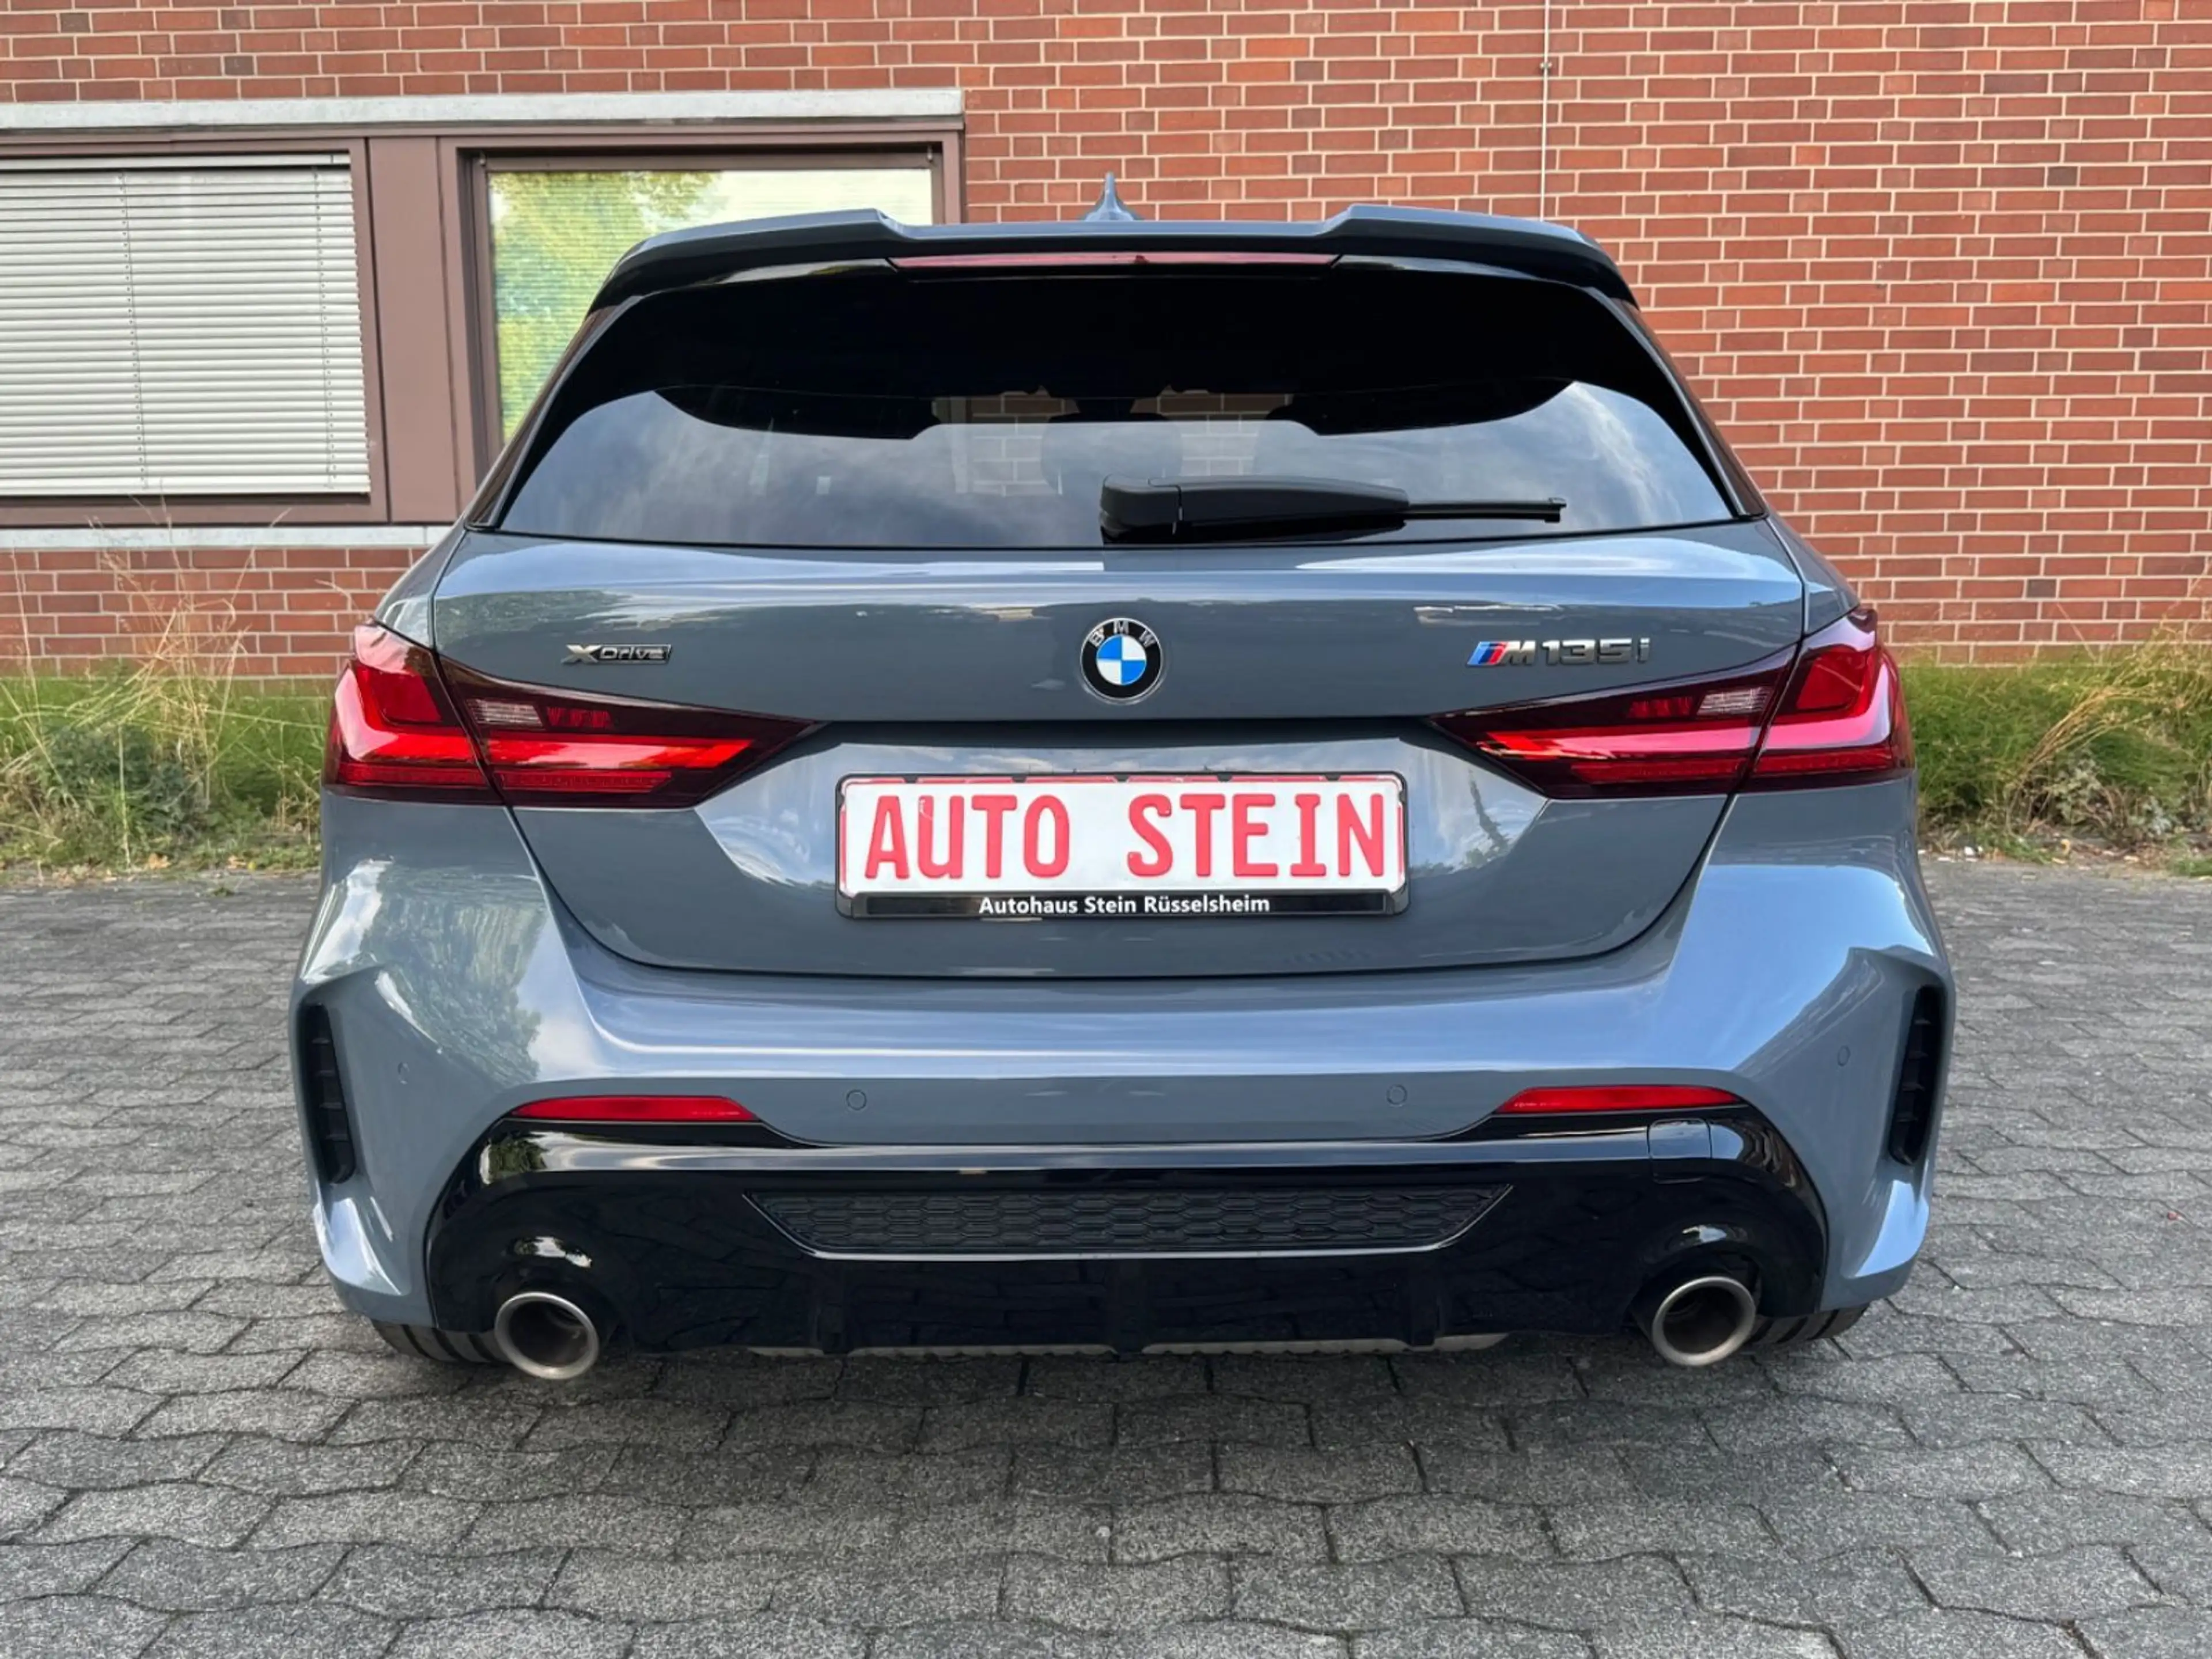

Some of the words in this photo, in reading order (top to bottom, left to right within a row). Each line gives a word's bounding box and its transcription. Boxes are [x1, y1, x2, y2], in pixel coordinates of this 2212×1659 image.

[1089, 620, 1157, 648] BMW
[1499, 637, 1651, 666] M135i
[864, 794, 1070, 880] AUTO
[1127, 793, 1385, 878] STEIN
[978, 896, 1080, 916] Autohaus
[1084, 895, 1137, 915] Stein
[1143, 894, 1271, 915] Rüsselsheim
